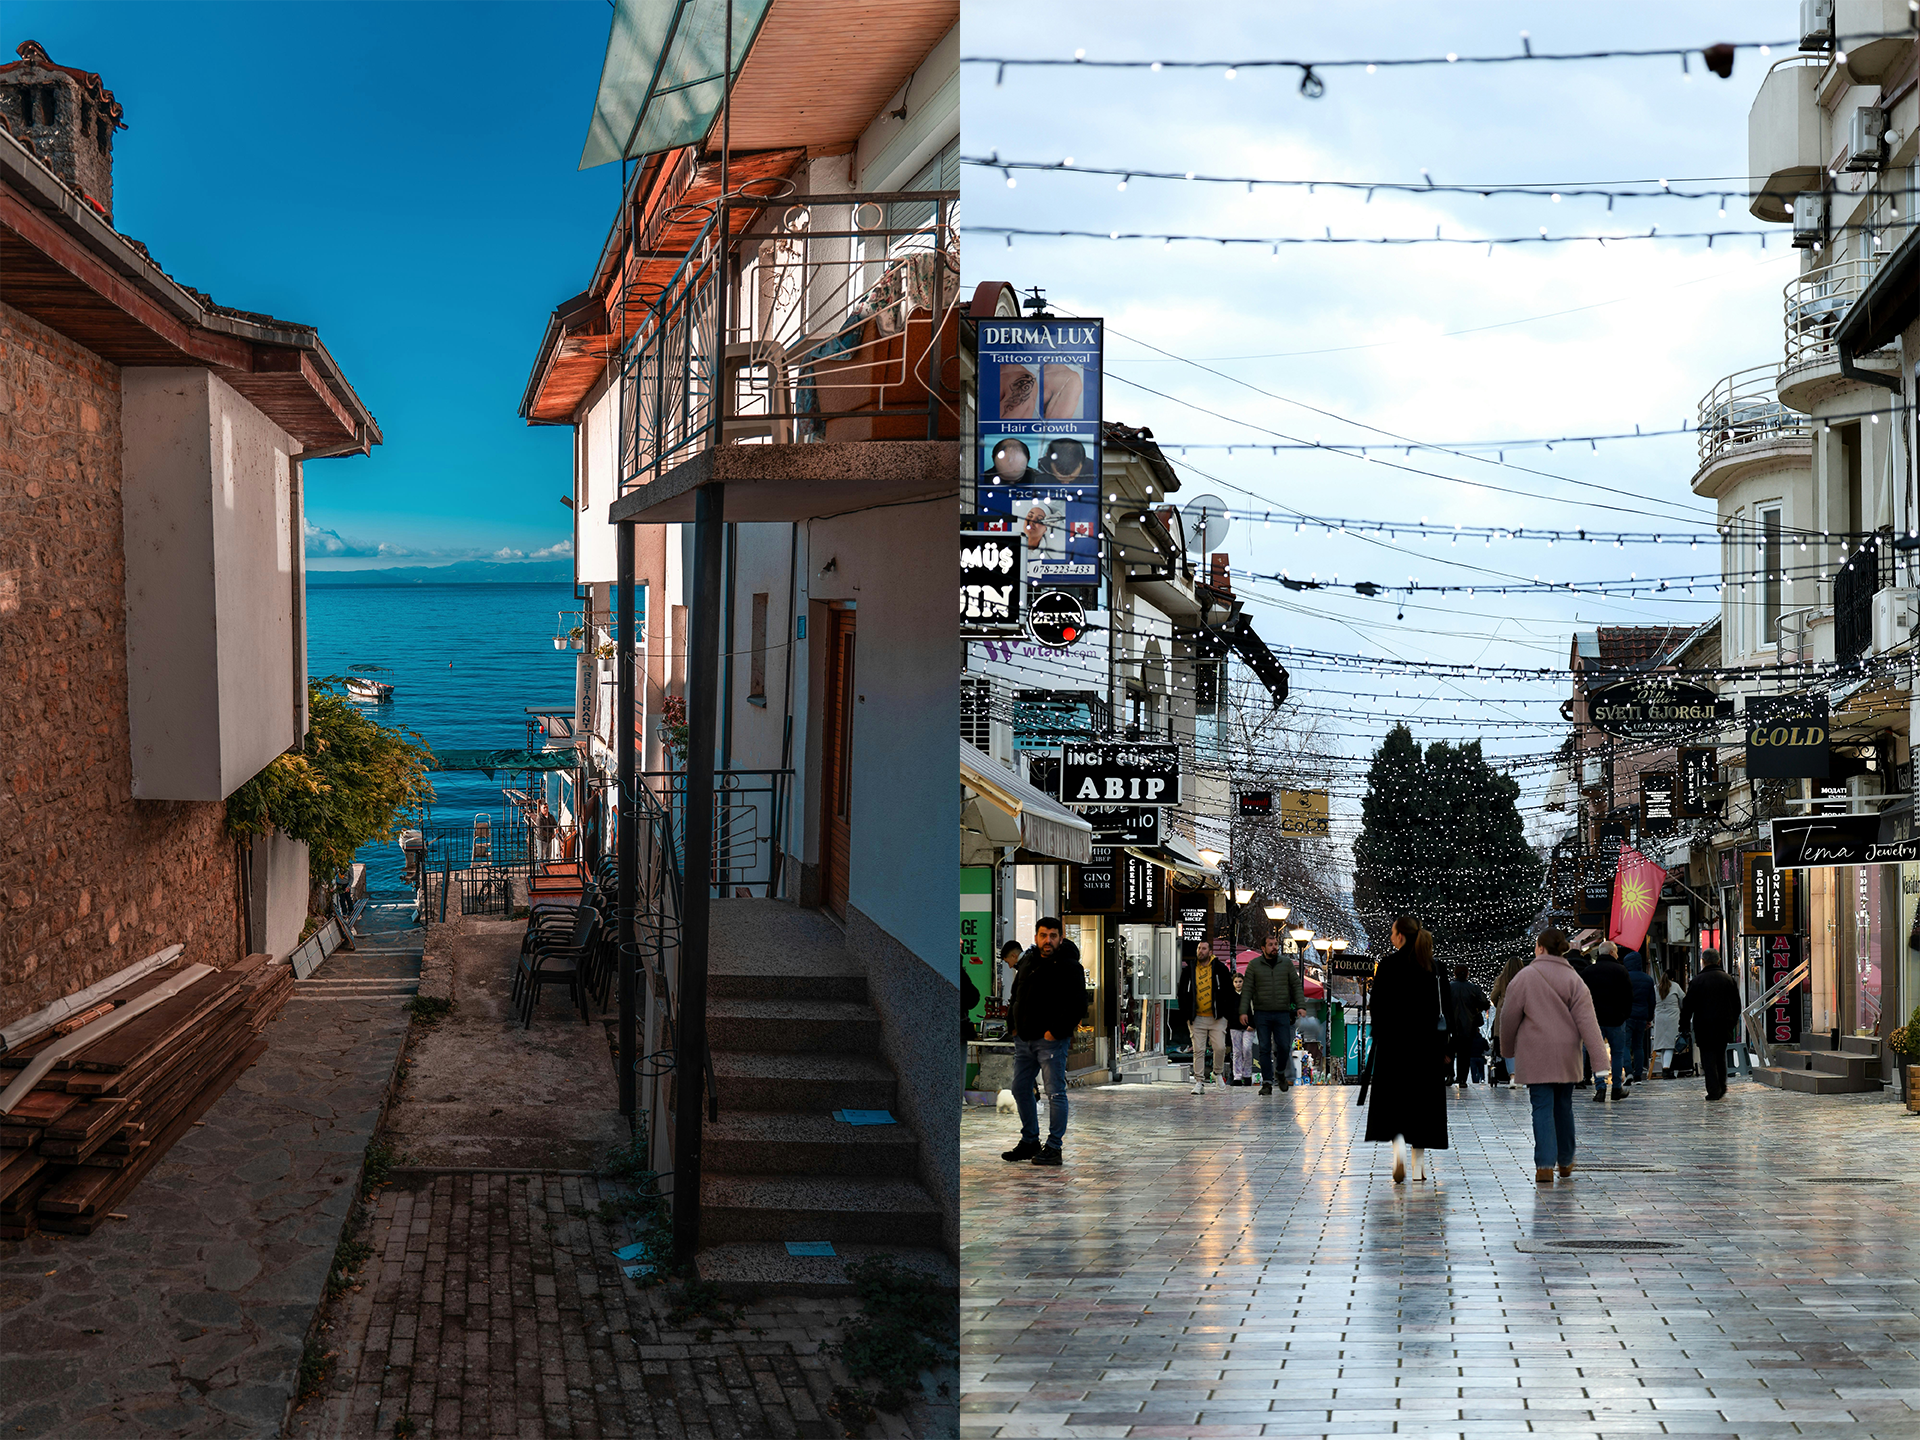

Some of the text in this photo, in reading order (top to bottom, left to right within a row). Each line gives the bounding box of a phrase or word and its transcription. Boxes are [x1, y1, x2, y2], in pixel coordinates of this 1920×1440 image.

[990, 353, 1090, 363] Tattoo removal
[1001, 423, 1078, 433] Hair Growth
[960, 542, 1014, 574] MÜŞ
[1033, 565, 1090, 574] 078-223-433
[582, 672, 592, 729] RESTAURANT
[1595, 705, 1715, 720] SVETI GJORGJI
[1750, 727, 1825, 747] GOLD
[1076, 777, 1165, 800] ABIP
[1782, 824, 1917, 862] Tema Jewelry
[1084, 873, 1111, 881] GINO
[1756, 869, 1764, 918] БОНАТИ
[1334, 959, 1375, 971] TOBACCO
